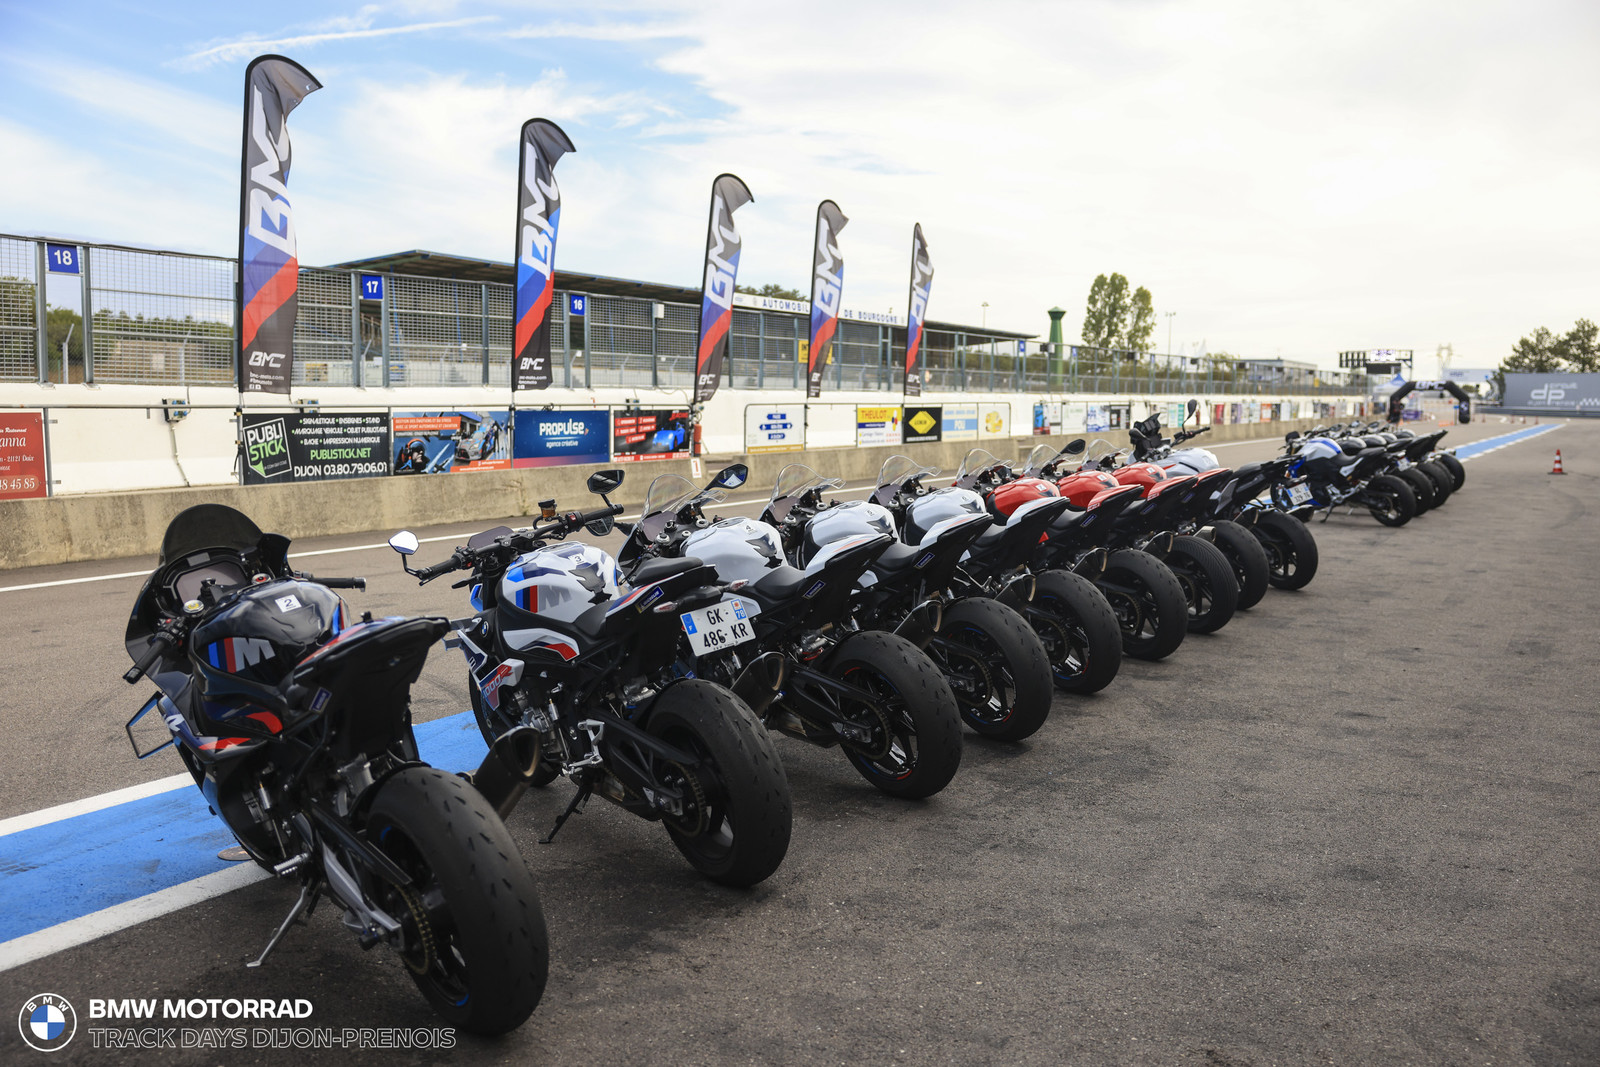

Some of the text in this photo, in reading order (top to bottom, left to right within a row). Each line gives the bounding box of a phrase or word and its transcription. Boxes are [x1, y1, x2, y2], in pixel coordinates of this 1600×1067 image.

[54, 249, 73, 266] 18
[366, 280, 379, 293] 17
[573, 299, 583, 310] 16
[762, 298, 898, 324] AUTOMOBIL DE BOURGOGNE
[249, 351, 286, 368] BMC
[520, 357, 545, 370] BMC
[1415, 381, 1447, 390] BMC
[366, 416, 380, 424] STAND
[247, 422, 283, 446] PUBLI
[0, 436, 26, 448] anna
[546, 441, 561, 449] agence
[250, 437, 286, 461] STICK
[310, 447, 372, 460] PUBLISTICK.NET
[294, 465, 322, 478] DIJON
[10, 478, 22, 490] 45
[23, 477, 35, 489] 85
[284, 598, 292, 607] 2
[735, 610, 746, 619] 78
